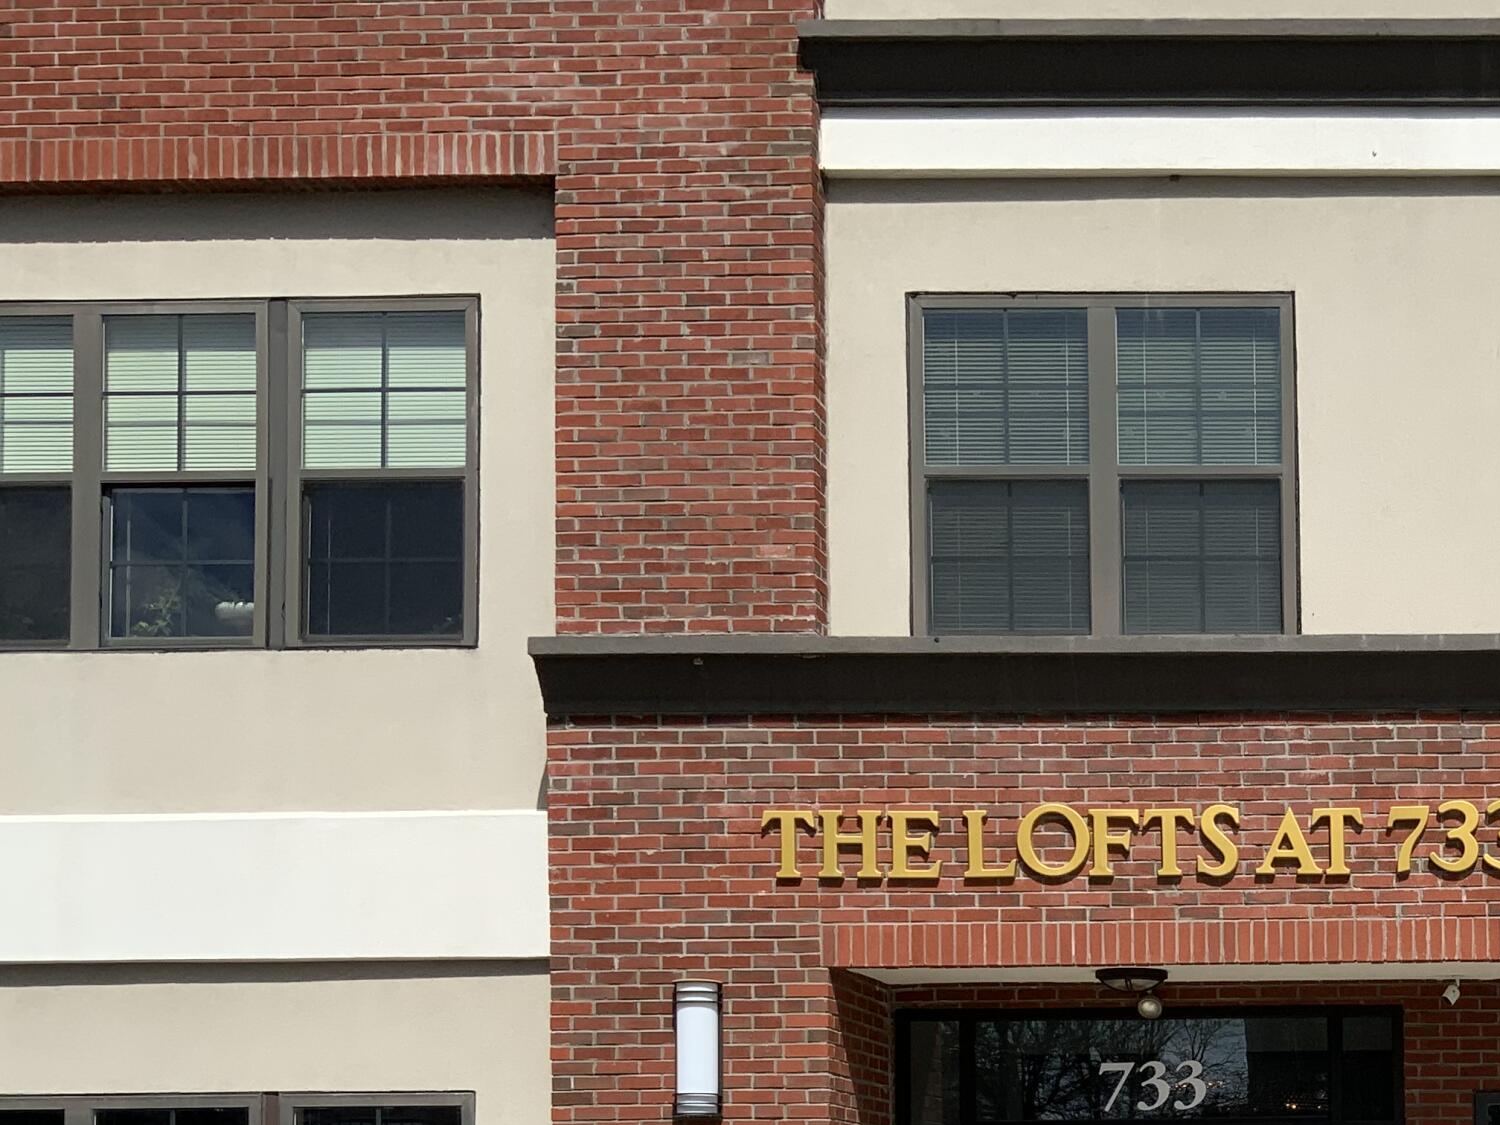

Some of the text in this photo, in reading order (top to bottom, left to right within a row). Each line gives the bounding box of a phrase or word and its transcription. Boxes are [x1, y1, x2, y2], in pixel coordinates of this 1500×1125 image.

[761, 808, 943, 881] THE
[962, 804, 1241, 880] LOFTS
[1256, 806, 1364, 878] AT
[1098, 1060, 1207, 1112] 733
